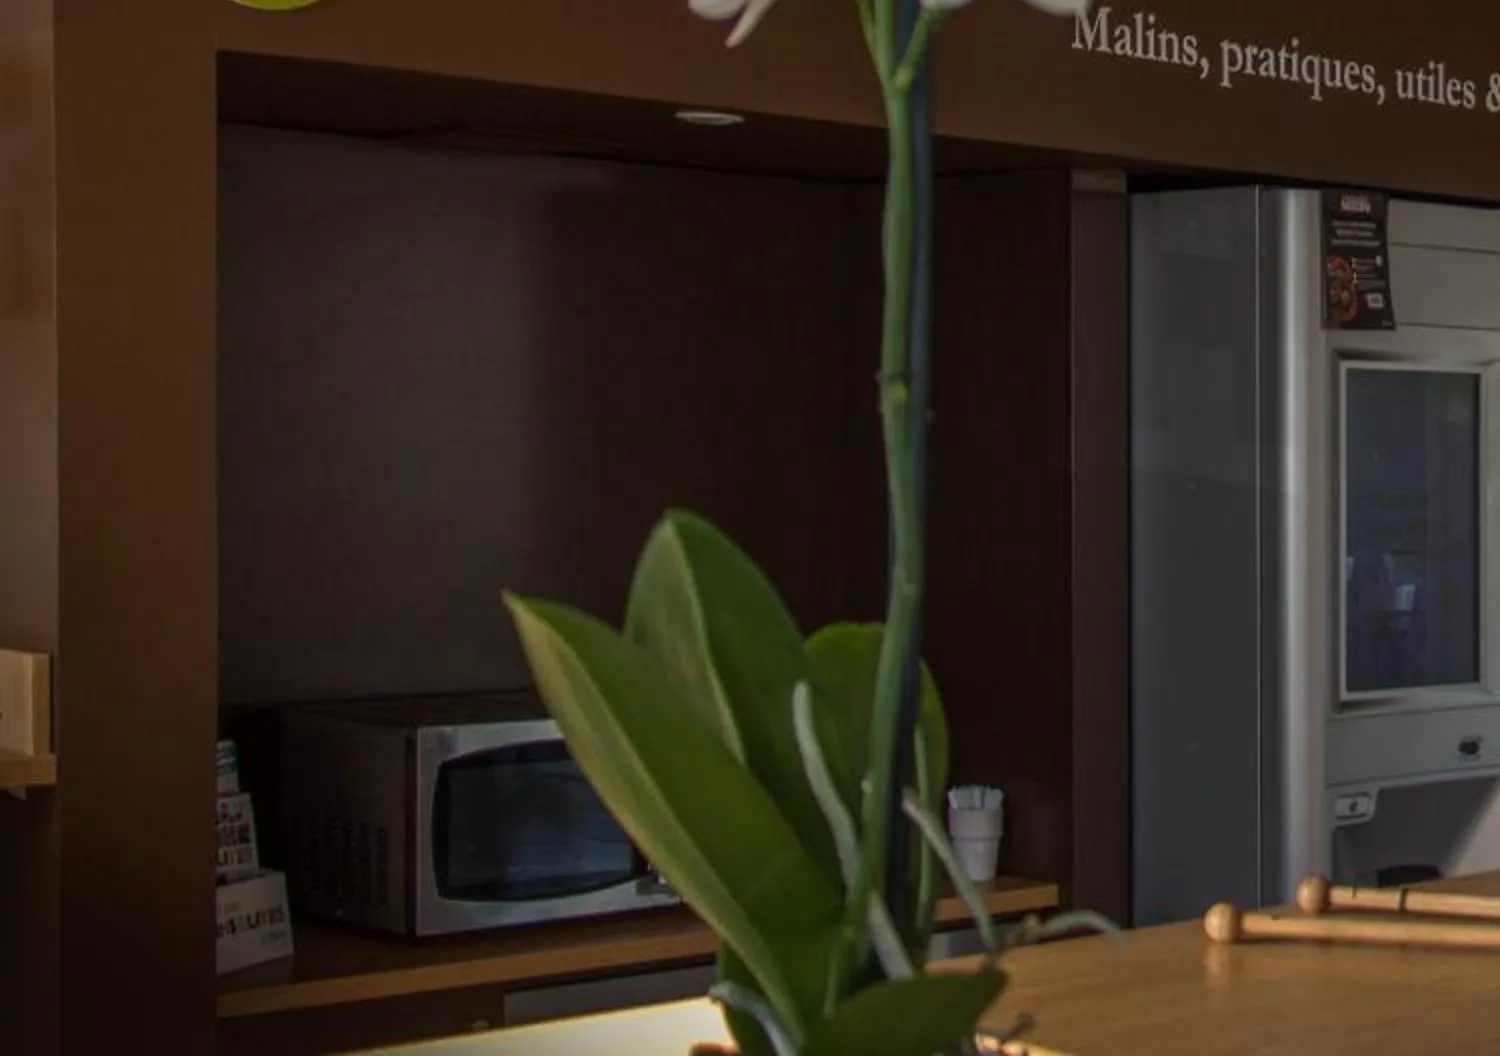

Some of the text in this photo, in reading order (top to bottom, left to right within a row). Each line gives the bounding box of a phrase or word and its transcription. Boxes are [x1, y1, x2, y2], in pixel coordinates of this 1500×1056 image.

[1071, 6, 1211, 80] Malins,
[1219, 37, 1386, 104] pratiques,
[1396, 60, 1476, 110] utiles
